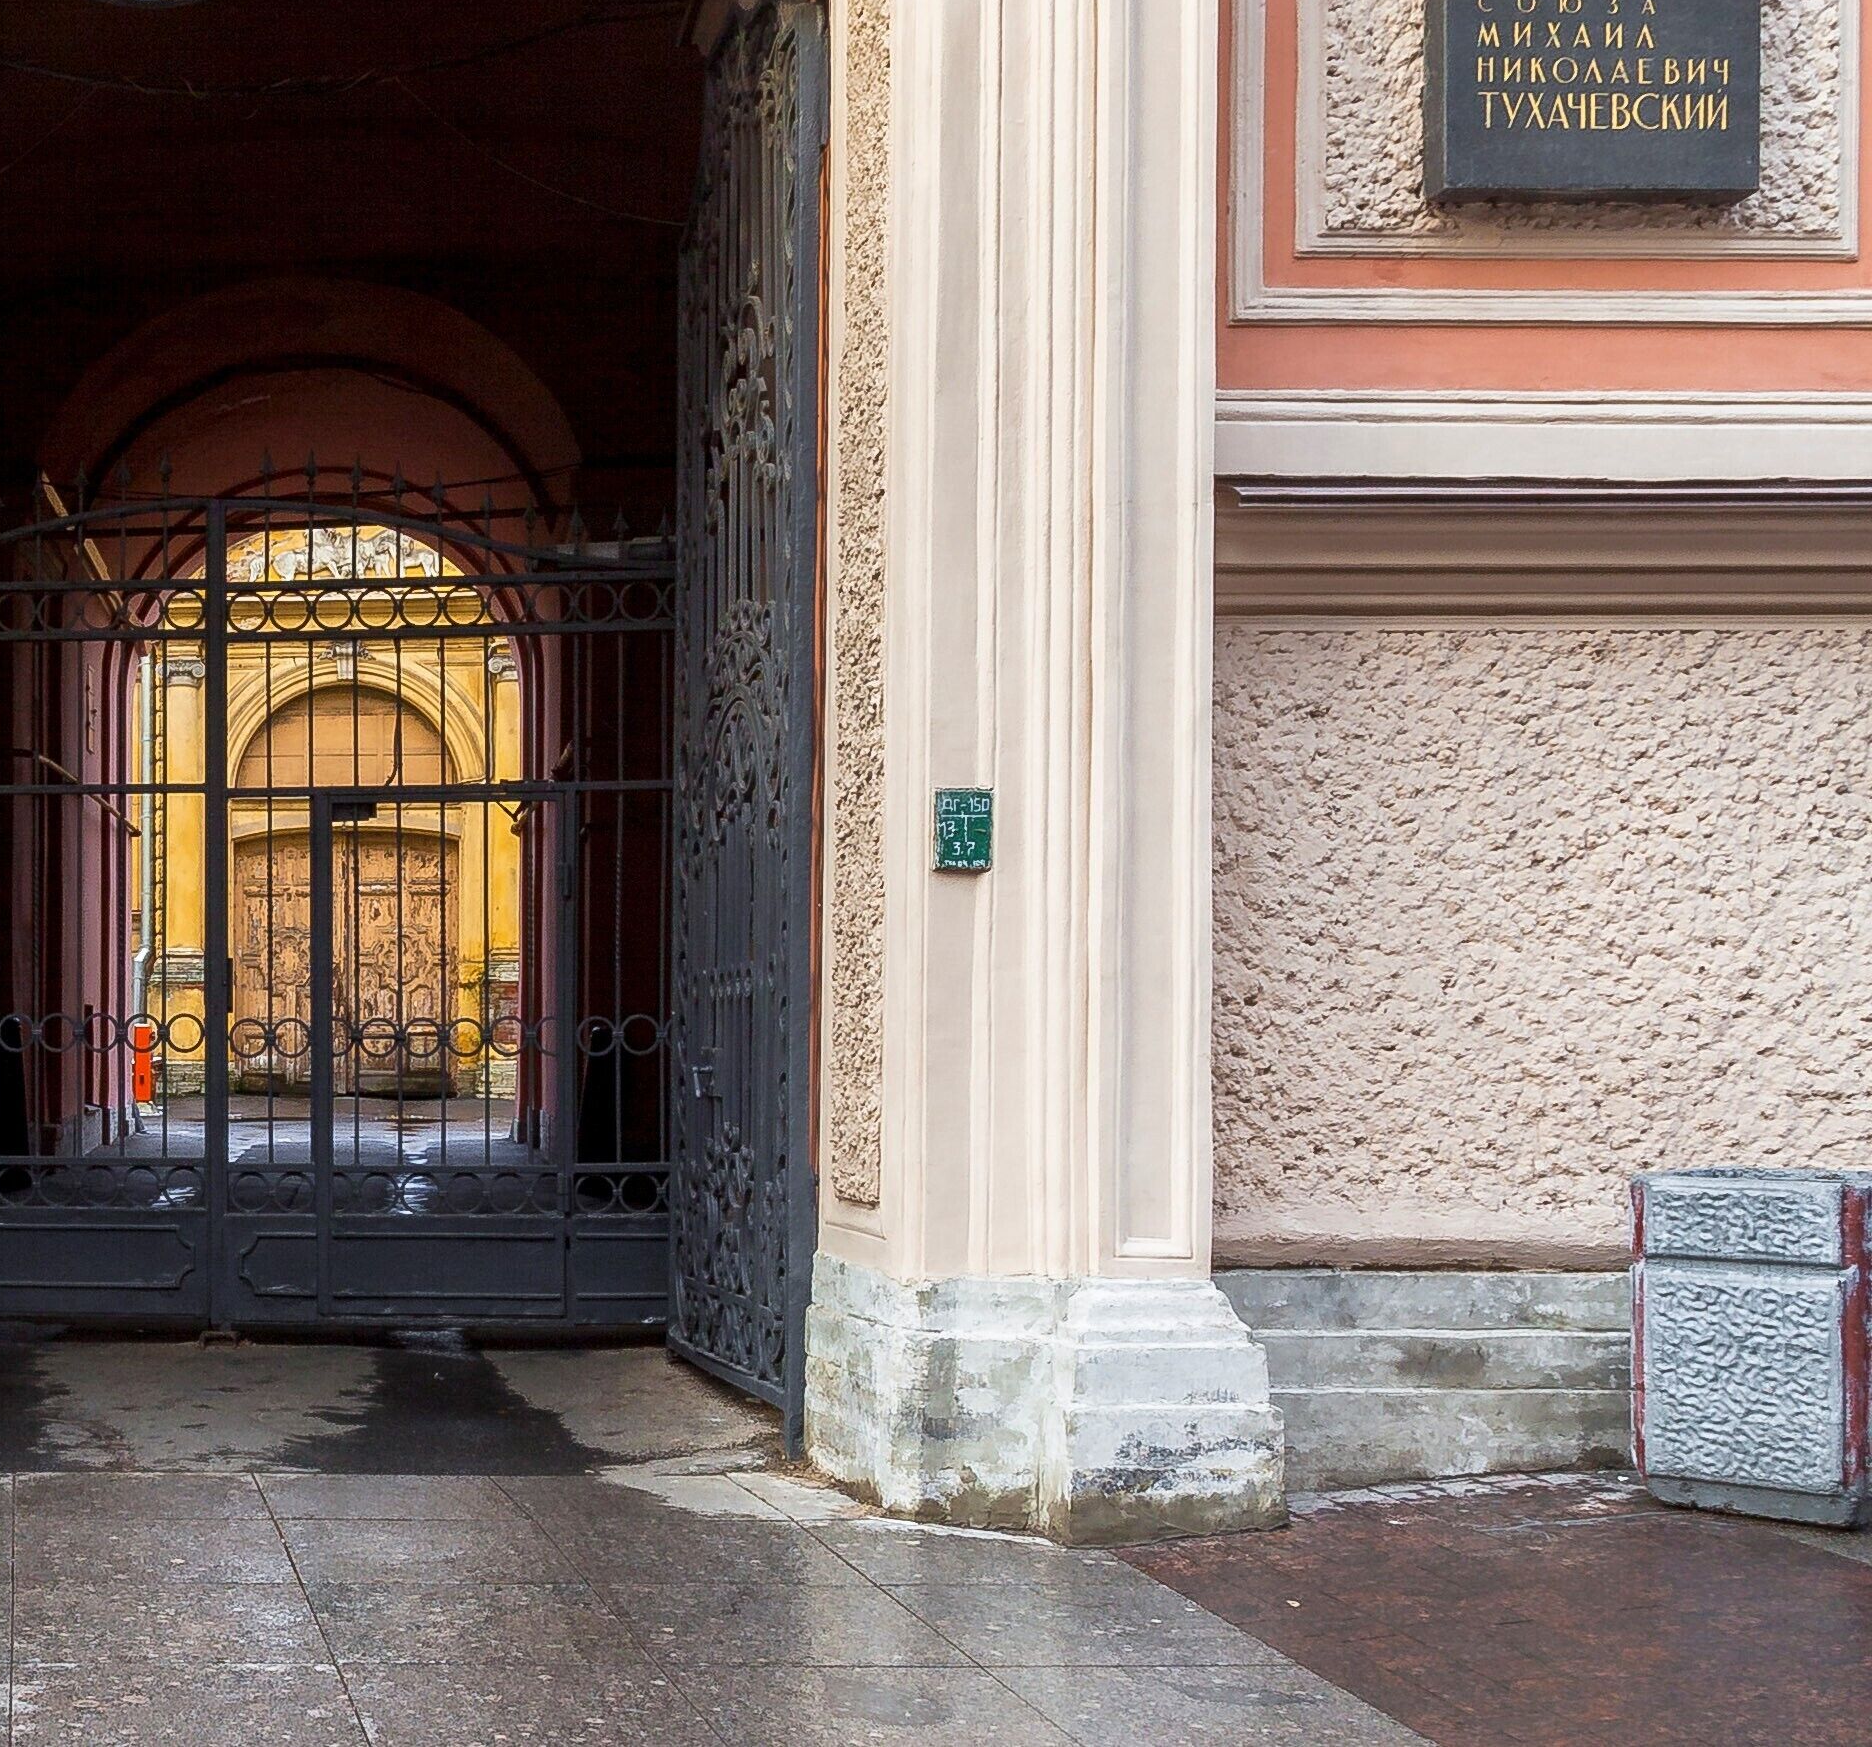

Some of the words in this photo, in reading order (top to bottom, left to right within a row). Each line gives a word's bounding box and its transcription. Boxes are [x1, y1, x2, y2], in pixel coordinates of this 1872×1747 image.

[1478, 22, 1655, 49] МИХАИЛ
[1477, 56, 1729, 85] НИКОЛАЕВИЧ
[1478, 87, 1729, 131] ТУХАЧЕВСКИЙ
